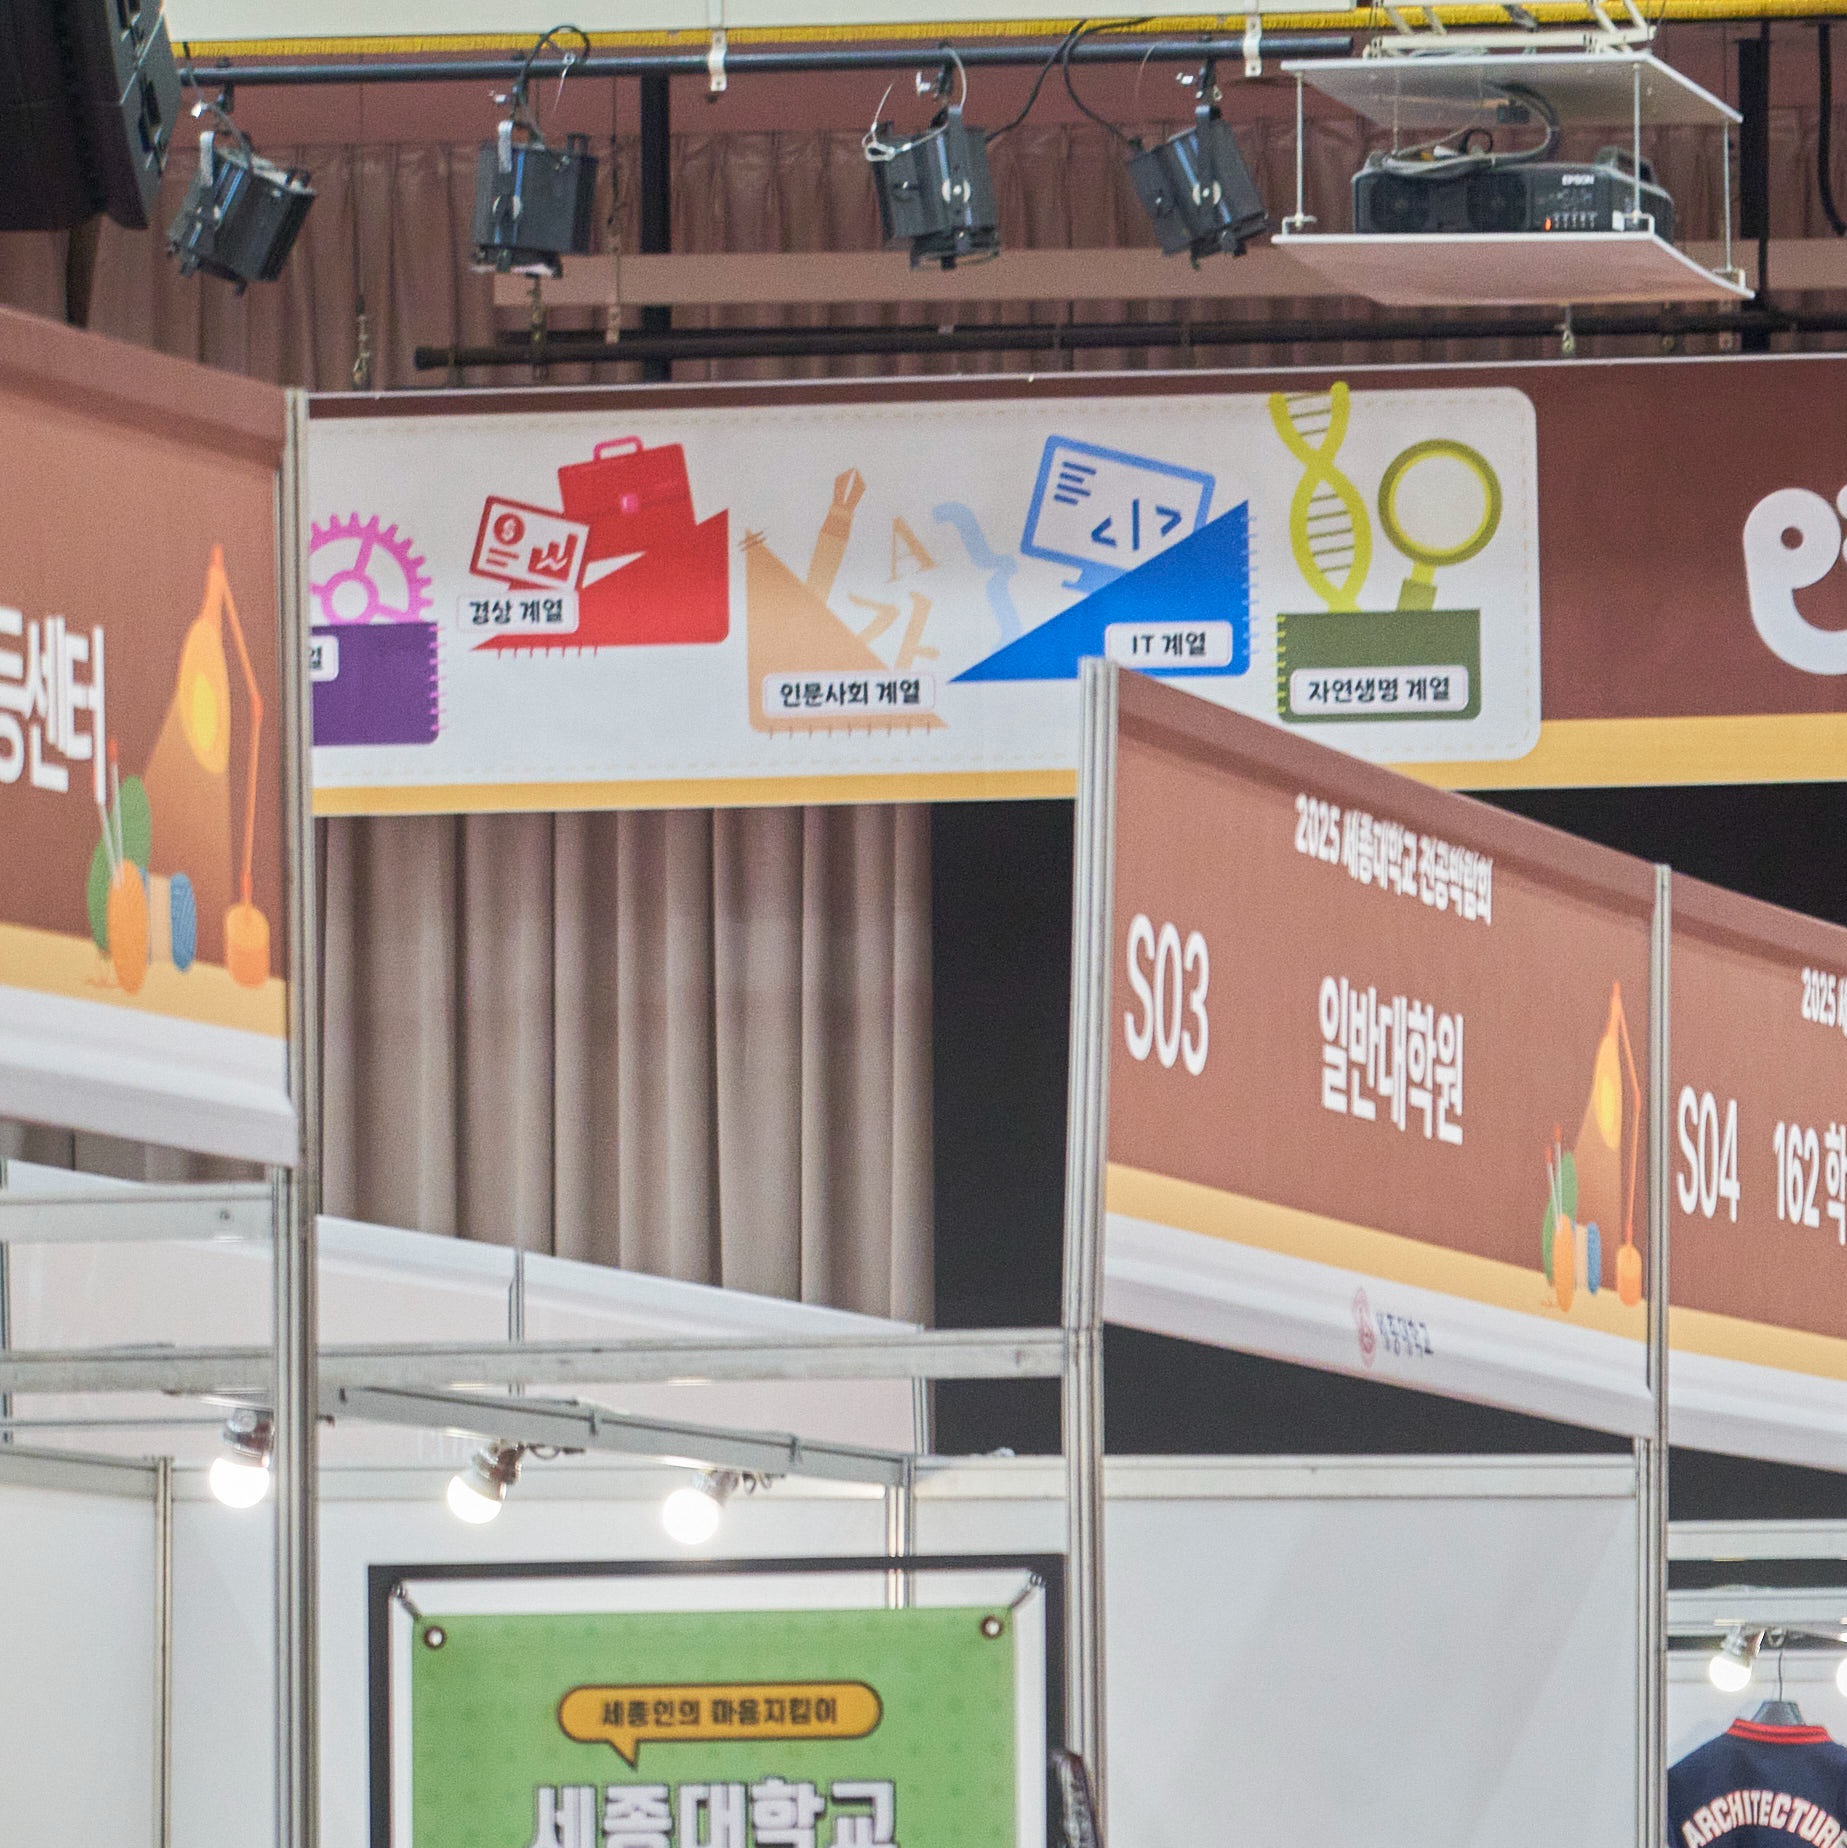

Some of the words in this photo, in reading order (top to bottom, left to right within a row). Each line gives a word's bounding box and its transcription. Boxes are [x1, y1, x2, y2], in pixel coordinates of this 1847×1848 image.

[1562, 174, 1595, 186] EPSON
[468, 598, 515, 625] 경상
[521, 597, 566, 624] 계열
[1131, 634, 1153, 656] IT
[1162, 630, 1208, 658] 계열
[778, 677, 870, 709] 인문사회
[875, 675, 922, 706] 계열
[1304, 674, 1398, 706] 자연생명
[1404, 672, 1453, 704] 계열
[1295, 794, 1340, 863] 2025
[1343, 809, 1417, 899] 세종대학교
[1123, 913, 1210, 1076] S03
[1801, 966, 1836, 1027] 2025
[1318, 976, 1464, 1145] 일반대학원
[1677, 1085, 1740, 1223] S04
[1773, 1120, 1820, 1228] 162
